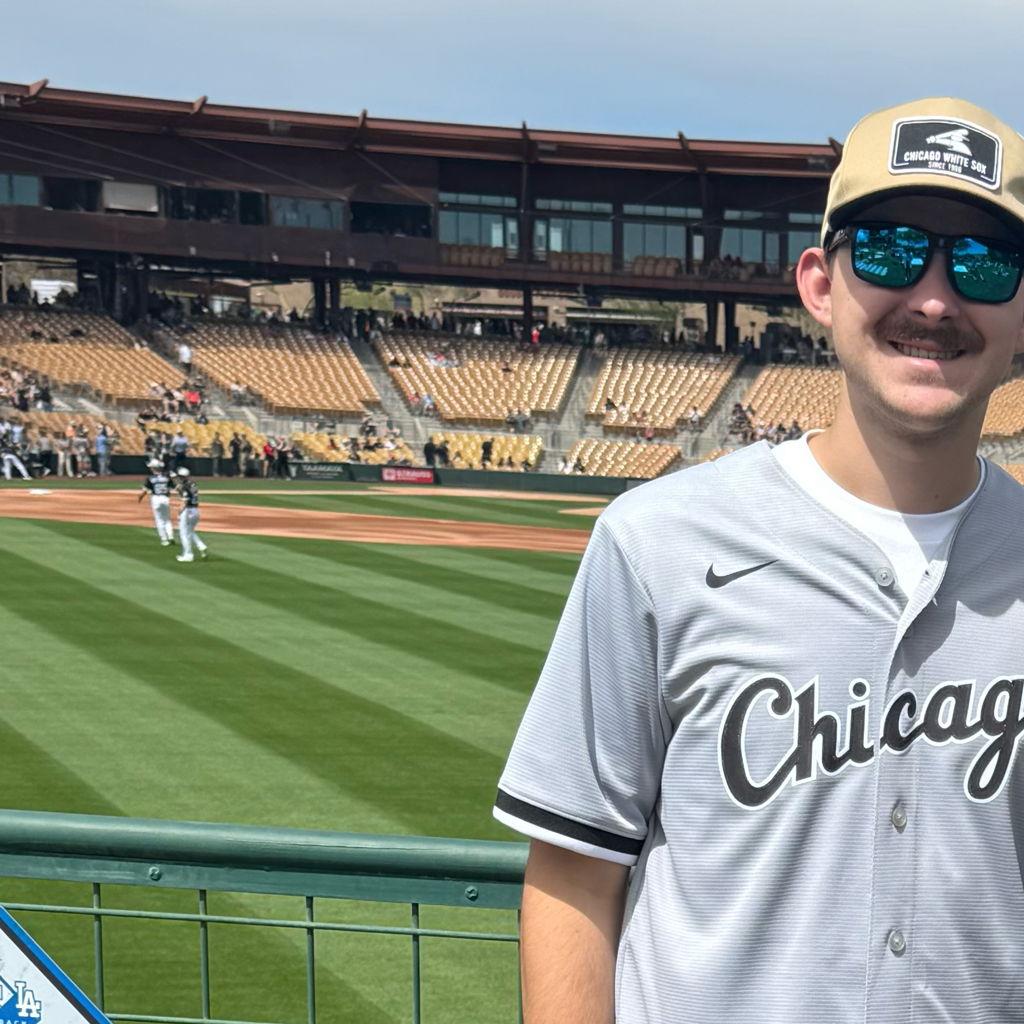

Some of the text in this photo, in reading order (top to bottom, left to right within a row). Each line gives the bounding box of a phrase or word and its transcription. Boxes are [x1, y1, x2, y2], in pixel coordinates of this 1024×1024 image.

[903, 150, 987, 175] CHICAGO WHITE SOX
[927, 161, 946, 170] SINCE
